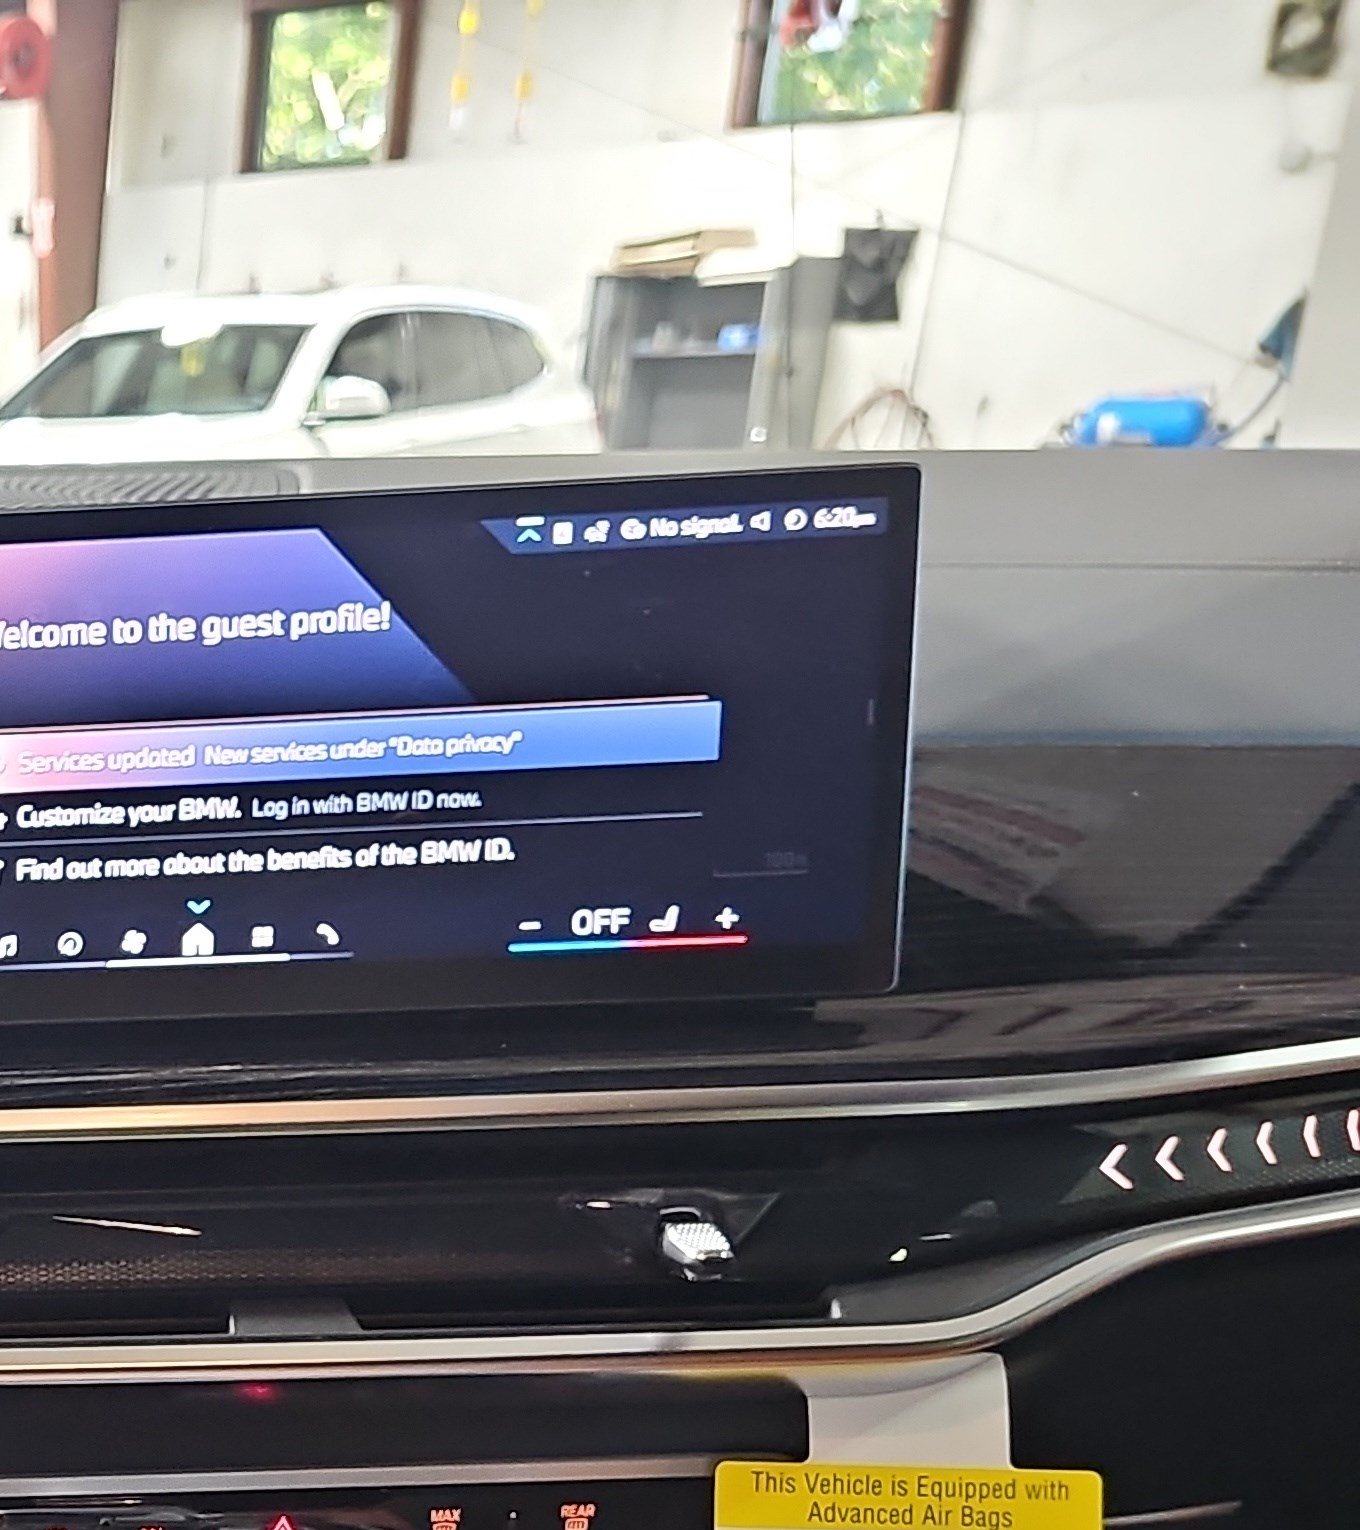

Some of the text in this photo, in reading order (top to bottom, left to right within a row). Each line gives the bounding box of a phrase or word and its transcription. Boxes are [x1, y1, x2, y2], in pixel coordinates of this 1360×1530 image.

[649, 517, 678, 538] No
[112, 616, 143, 645] to
[147, 612, 197, 643] the
[201, 609, 286, 646] guest
[290, 601, 391, 641] profile!
[17, 750, 106, 775] Services
[107, 744, 197, 774] updated
[204, 744, 249, 766] New
[250, 740, 329, 763] services
[330, 737, 387, 760] under
[16, 789, 483, 828] Customize your BMW. Log in with BMW ID now.
[15, 837, 516, 882] Find out more about the benefits of the BMW ID.
[571, 906, 632, 936] OFF
[751, 1472, 1070, 1503] This Vehicle is Equipped with
[430, 1508, 462, 1523] MAX
[560, 1503, 597, 1518] REAR
[807, 1501, 1013, 1530] Advanced Air Bags
